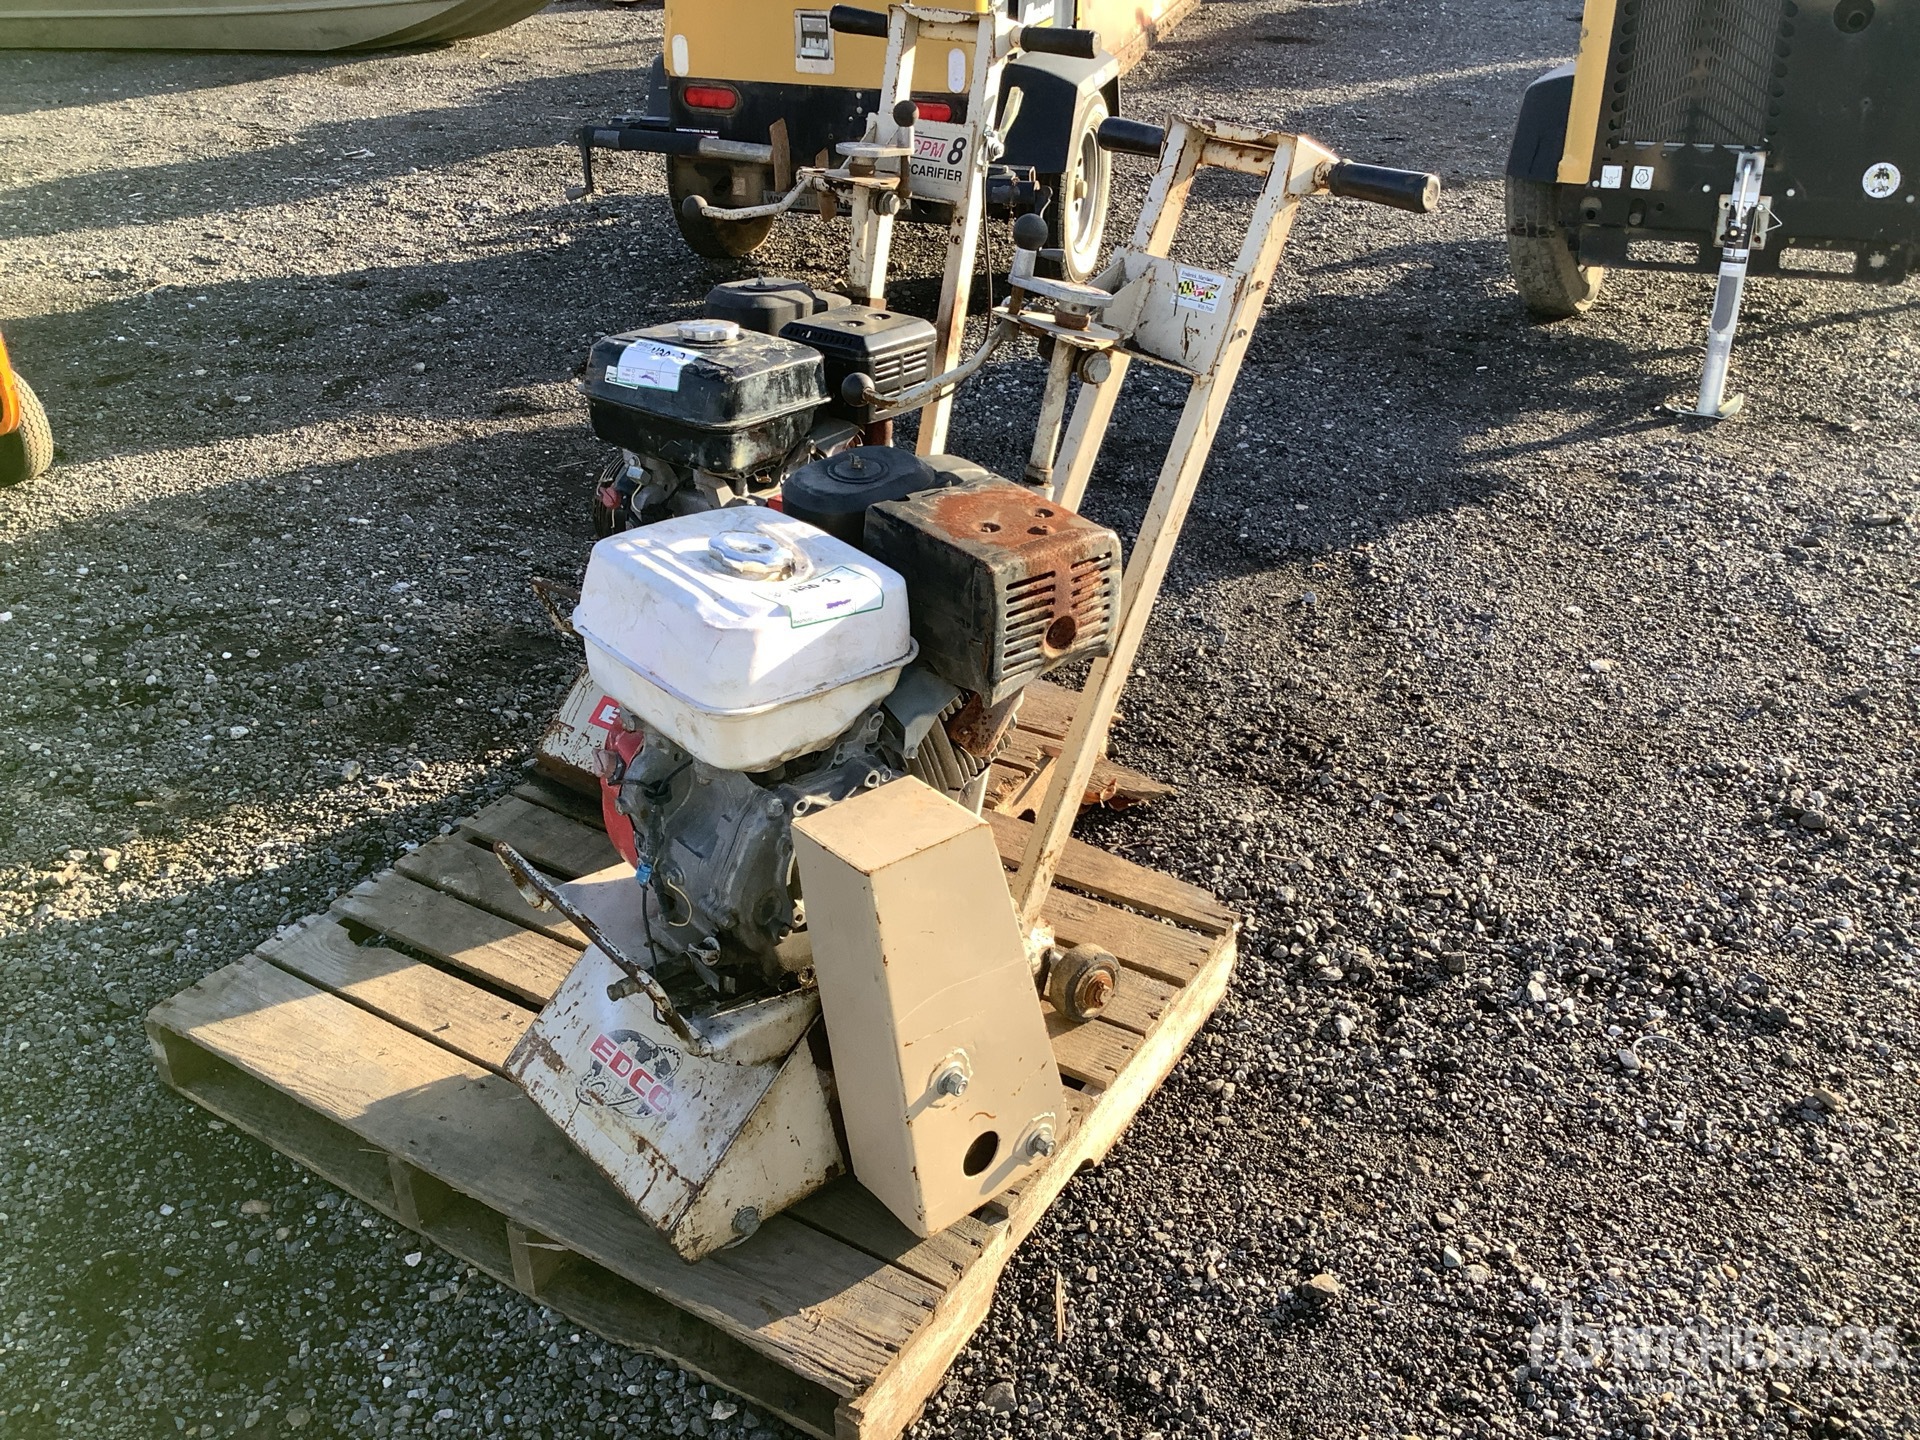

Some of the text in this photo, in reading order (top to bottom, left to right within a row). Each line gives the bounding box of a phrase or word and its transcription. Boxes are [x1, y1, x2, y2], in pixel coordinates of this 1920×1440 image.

[947, 137, 967, 165] 8
[910, 164, 962, 182] CARIFIER
[588, 1032, 672, 1113] EDCO
